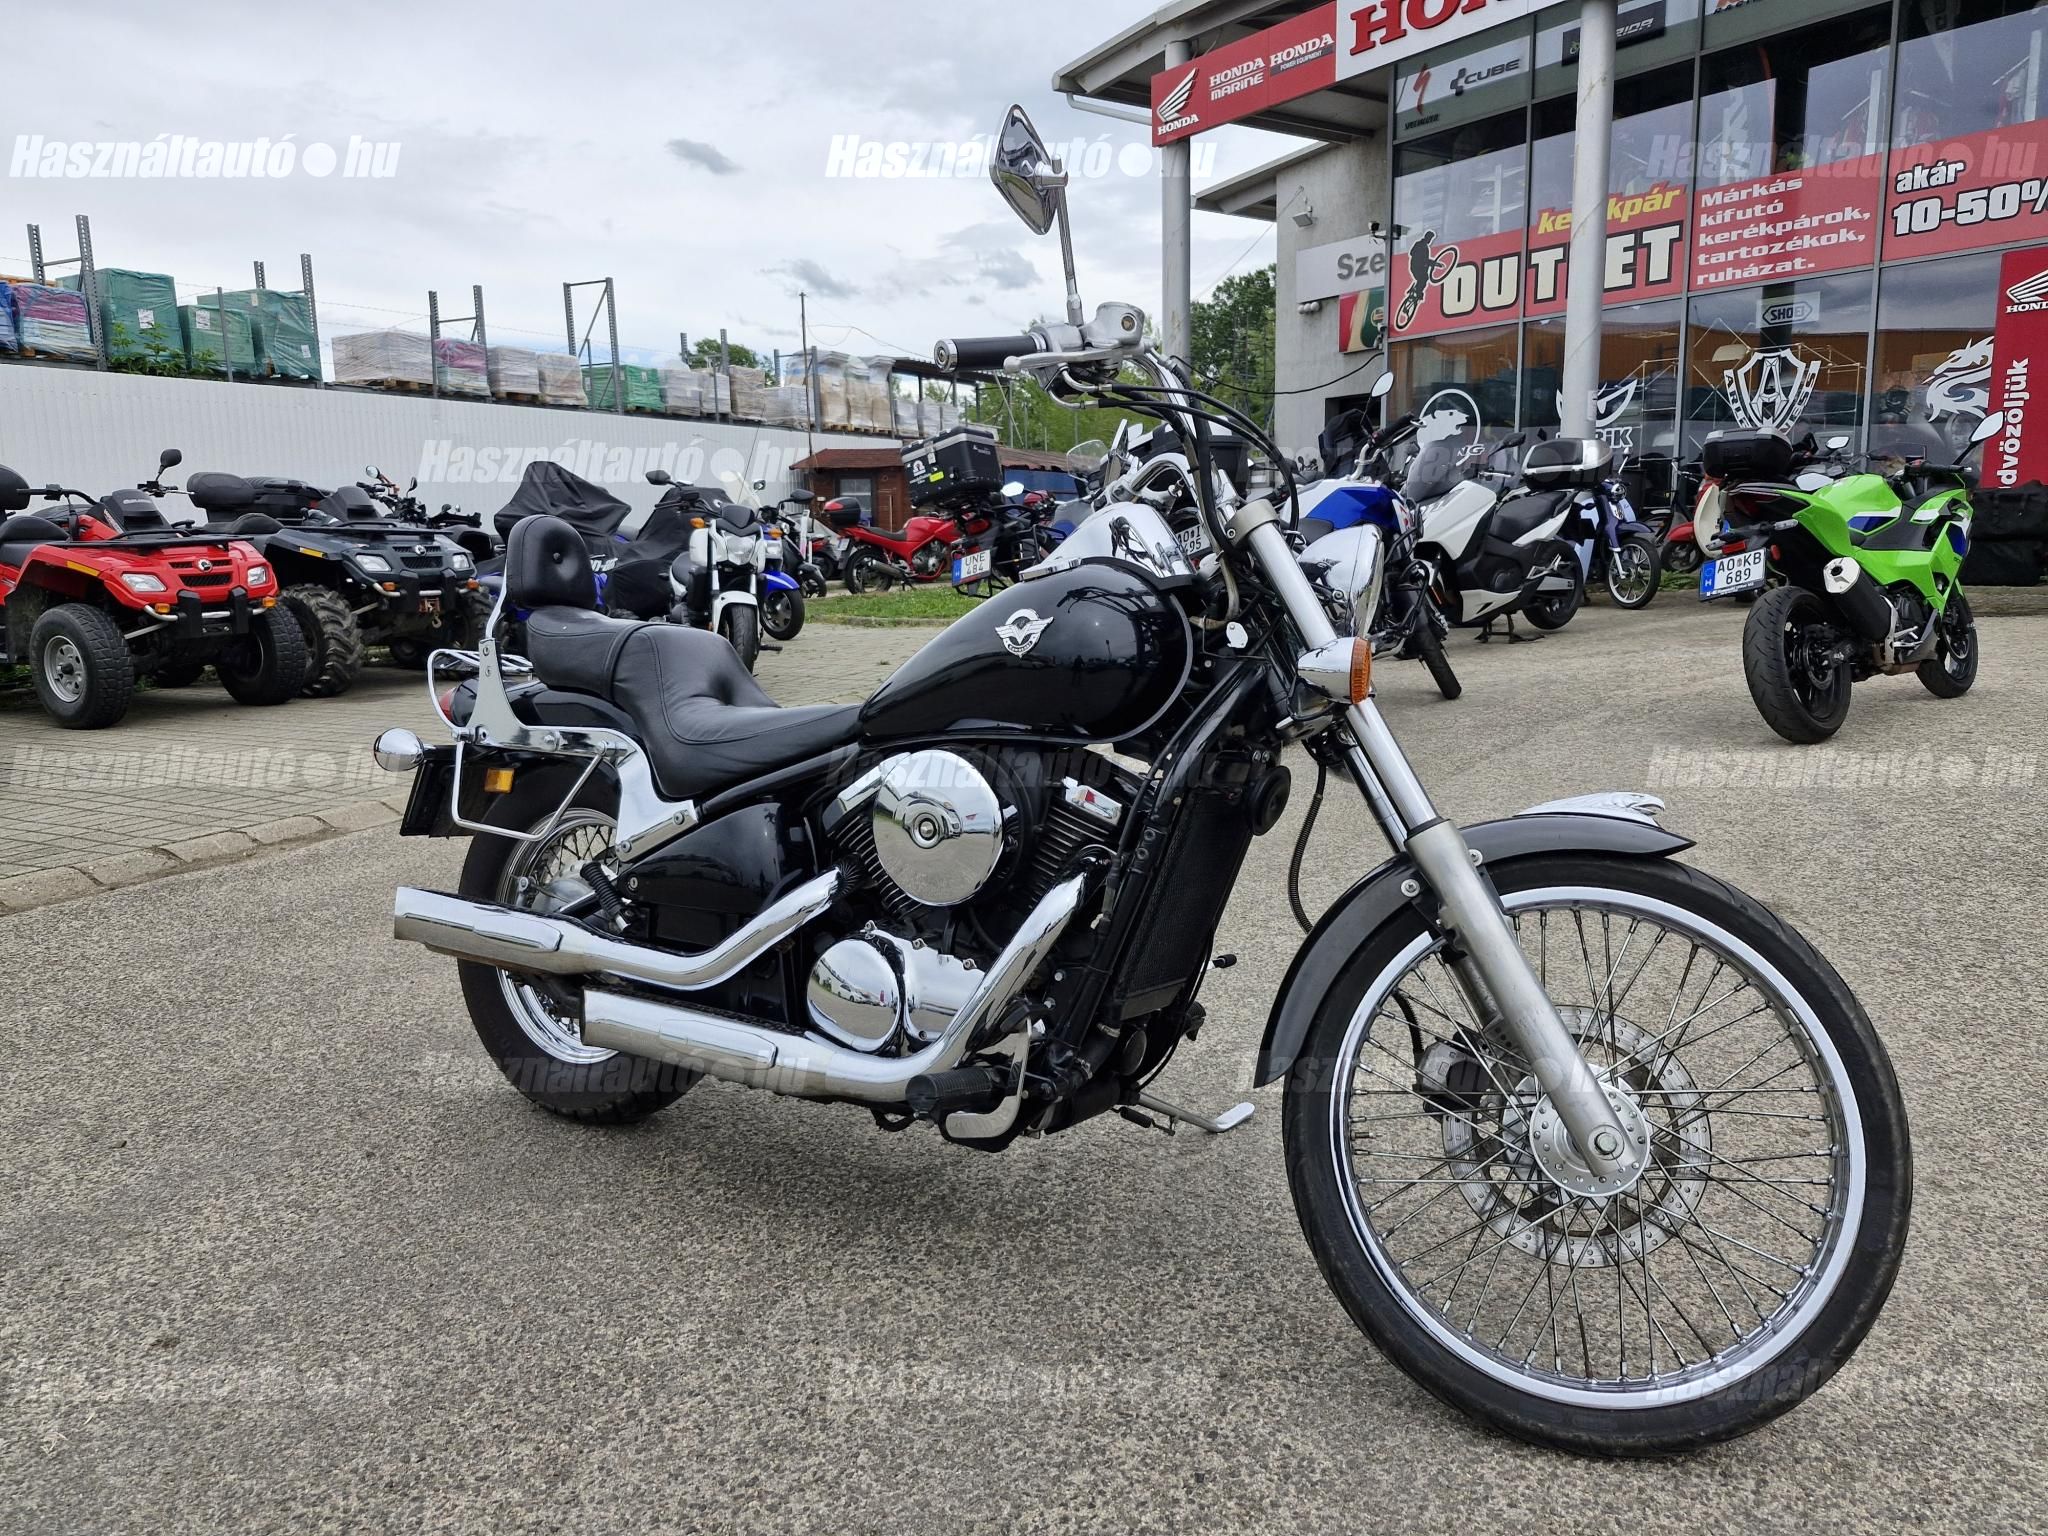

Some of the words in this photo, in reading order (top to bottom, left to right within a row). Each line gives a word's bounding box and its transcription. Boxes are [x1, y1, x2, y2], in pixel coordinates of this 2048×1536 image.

[1269, 33, 1335, 68] HONDA
[1208, 57, 1266, 88] HONDA
[1464, 58, 1520, 85] CUBE
[1210, 72, 1264, 101] MARINE
[1157, 113, 1199, 136] HONDA
[1896, 160, 1966, 193] akár
[1701, 178, 1803, 208] Márkás
[1538, 187, 1681, 235] kekpár
[1700, 199, 1784, 228] kifutó
[1699, 206, 1872, 247] kerékpárok,
[1697, 228, 1866, 266] tartozékok,
[1337, 252, 1385, 281] Sze
[1442, 220, 1684, 318] OUTET
[1696, 257, 1816, 286] ruházat.
[1996, 357, 2030, 489] dvözöljük
[965, 551, 986, 566] UNE
[1717, 558, 1735, 574] AO
[1743, 551, 1762, 567] KB
[1705, 578, 1712, 587] H
[1726, 567, 1751, 585] 689
